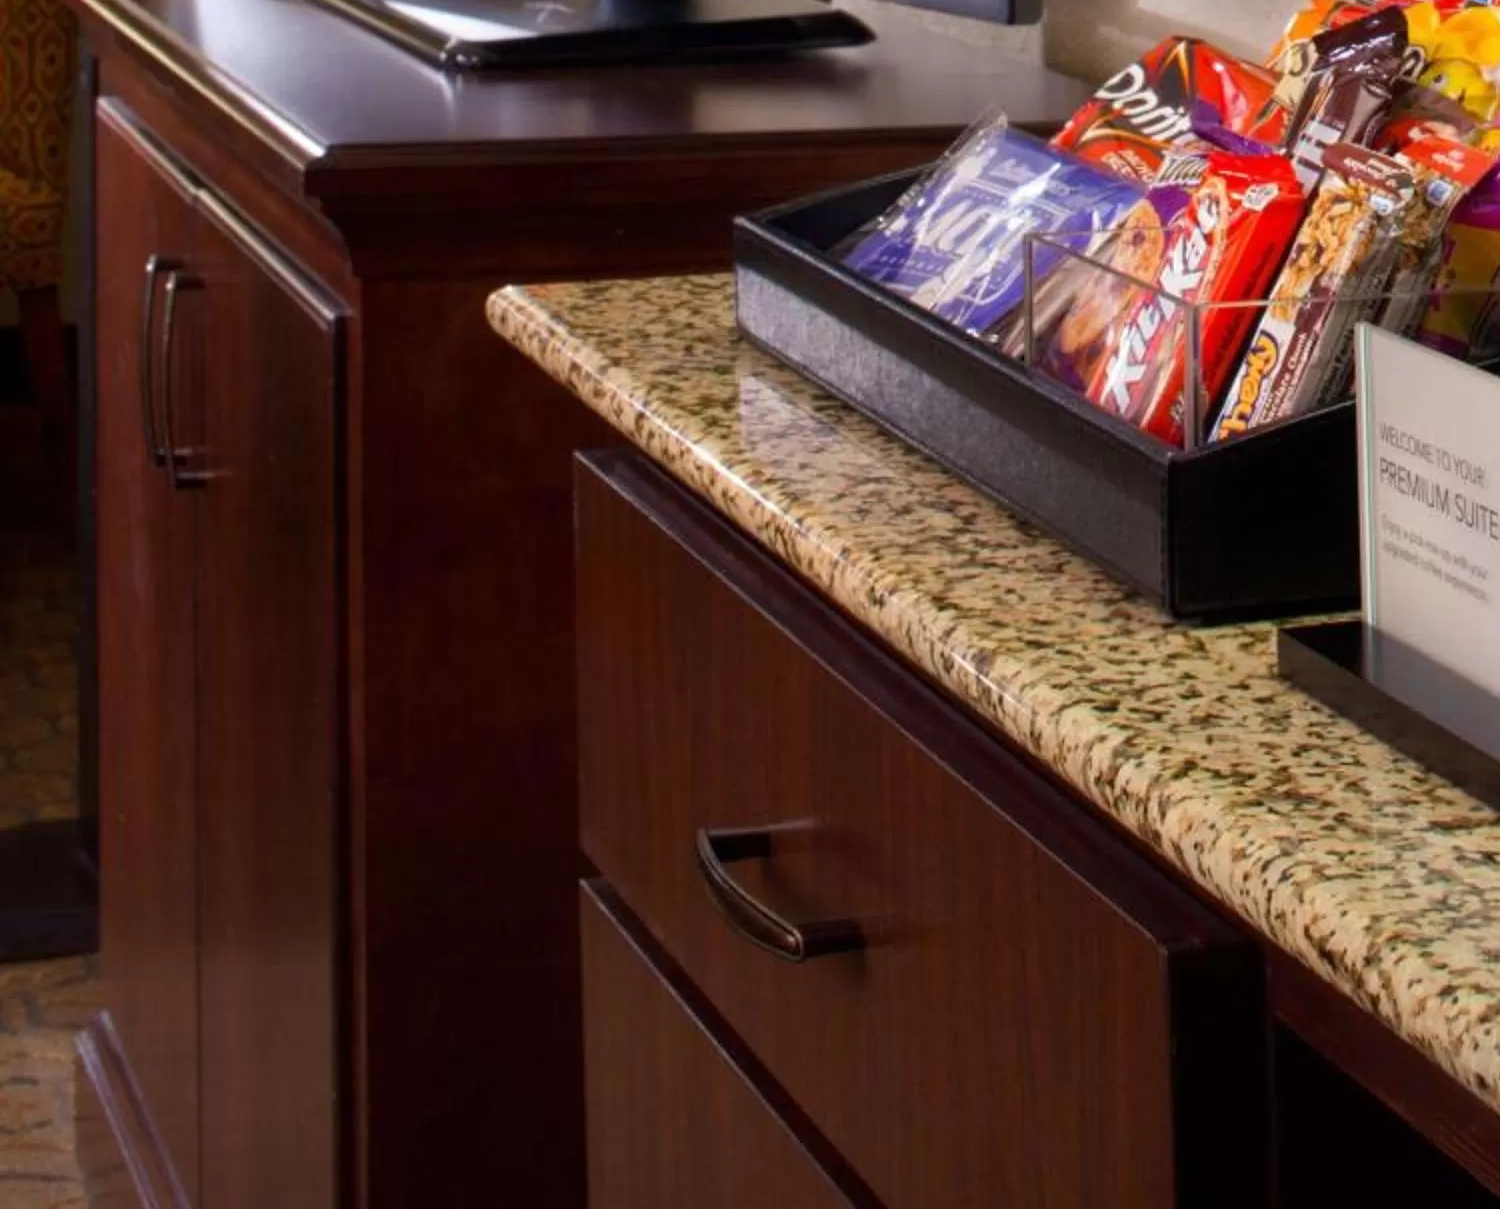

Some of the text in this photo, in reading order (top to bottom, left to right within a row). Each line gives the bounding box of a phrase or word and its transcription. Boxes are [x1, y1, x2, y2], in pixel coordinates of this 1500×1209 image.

[1094, 62, 1193, 141] Dorit
[1379, 422, 1487, 488] WELCOME TO YOUR
[1379, 456, 1500, 541] PREMIUM SUITE
